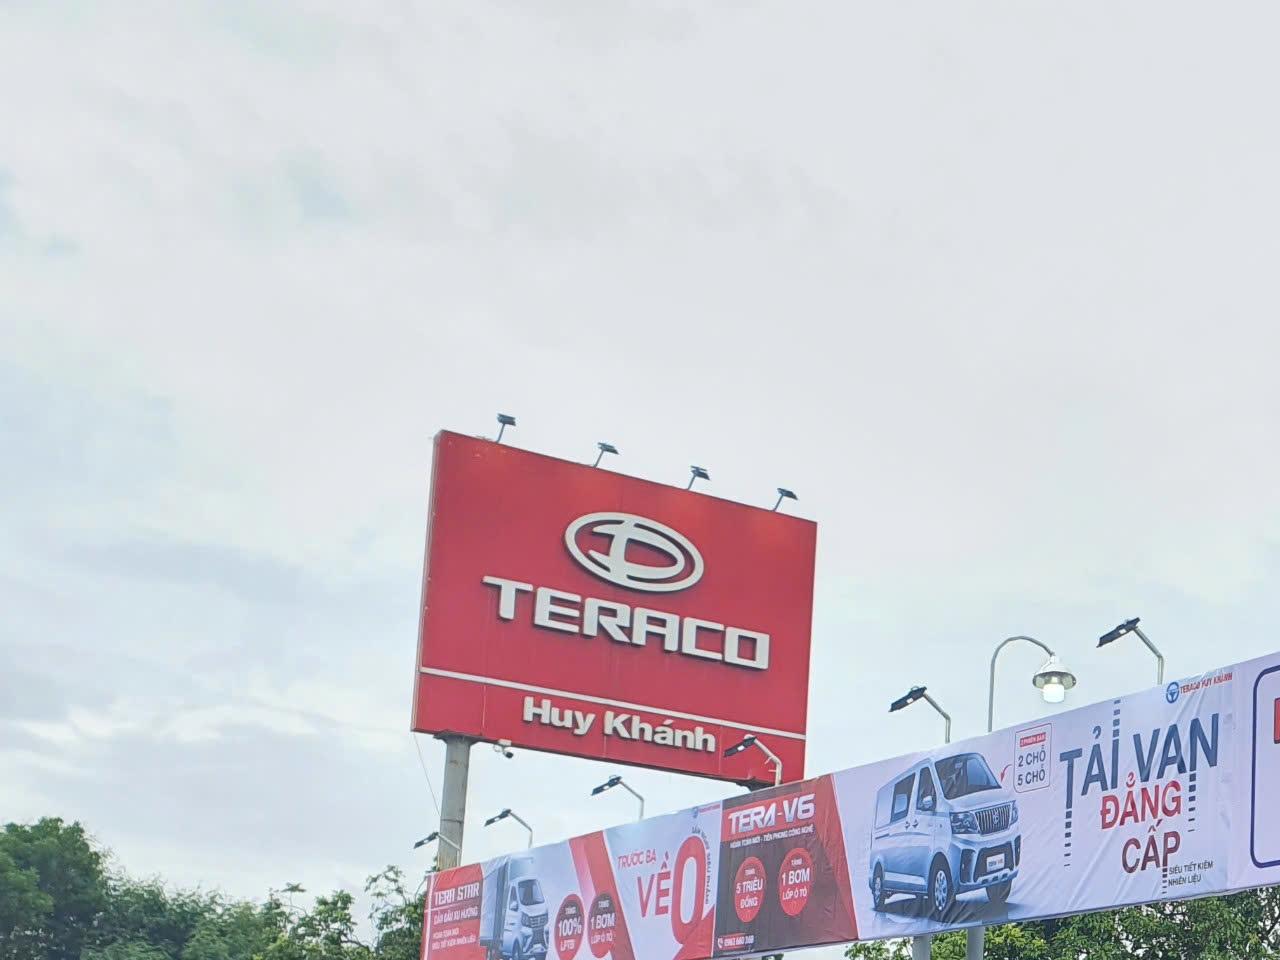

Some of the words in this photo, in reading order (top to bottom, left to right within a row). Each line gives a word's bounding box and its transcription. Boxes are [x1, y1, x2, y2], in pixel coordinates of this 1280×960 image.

[483, 576, 771, 670] TERACO
[522, 697, 596, 736] Huy
[604, 711, 717, 753] Khánh
[1018, 755, 1024, 767] 2
[1059, 725, 1121, 809] TẢI
[1133, 712, 1219, 783] VAN
[1017, 774, 1023, 786] 5
[1100, 772, 1181, 829] ĐẲNG
[1121, 819, 1181, 874] CẤP
[736, 882, 741, 893] 5
[782, 872, 786, 886] 1
[558, 916, 583, 937] 100%
